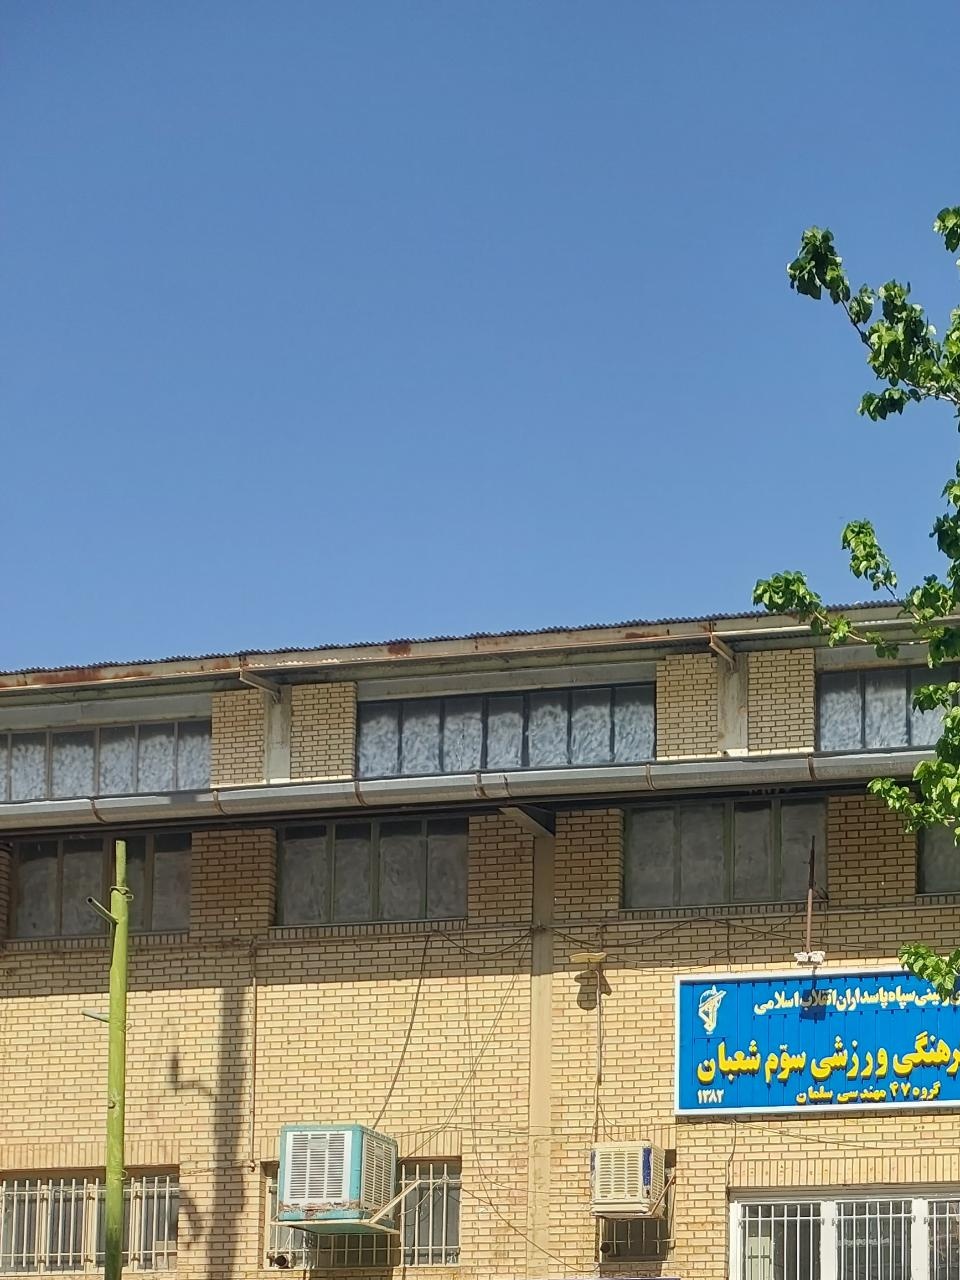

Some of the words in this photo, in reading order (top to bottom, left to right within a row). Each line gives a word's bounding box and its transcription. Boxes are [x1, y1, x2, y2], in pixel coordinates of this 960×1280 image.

[753, 990, 799, 1015] اسلامی
[800, 988, 836, 1011] انقلاب
[835, 986, 888, 1011] پاسداران
[889, 985, 915, 1009] سپاه
[697, 1039, 761, 1084] شعبان
[796, 1085, 833, 1103] سلمان
[837, 1086, 886, 1102] مهندسی
[912, 1081, 941, 1100] گروه
